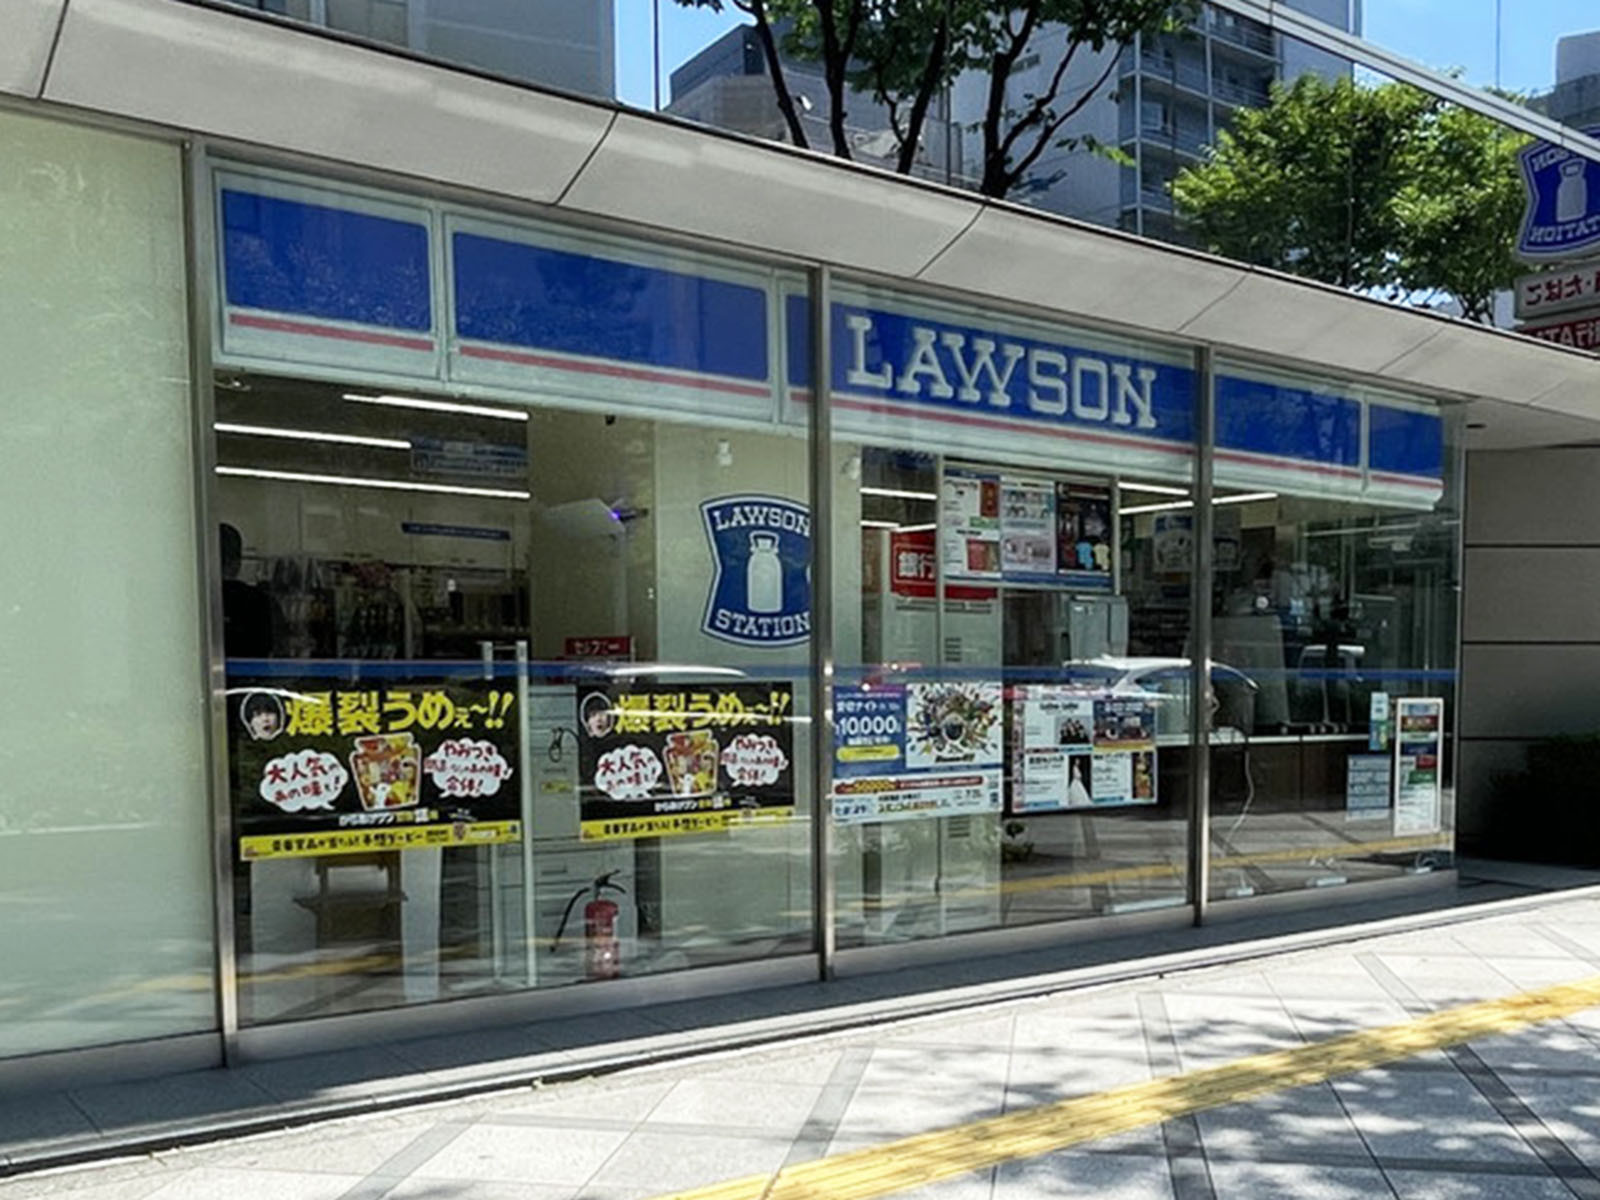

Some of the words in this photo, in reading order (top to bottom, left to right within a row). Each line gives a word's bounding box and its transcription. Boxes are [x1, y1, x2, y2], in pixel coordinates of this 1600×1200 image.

[846, 316, 1157, 429] LAWSON
[712, 506, 810, 537] LAWSON
[714, 608, 810, 637] STATION
